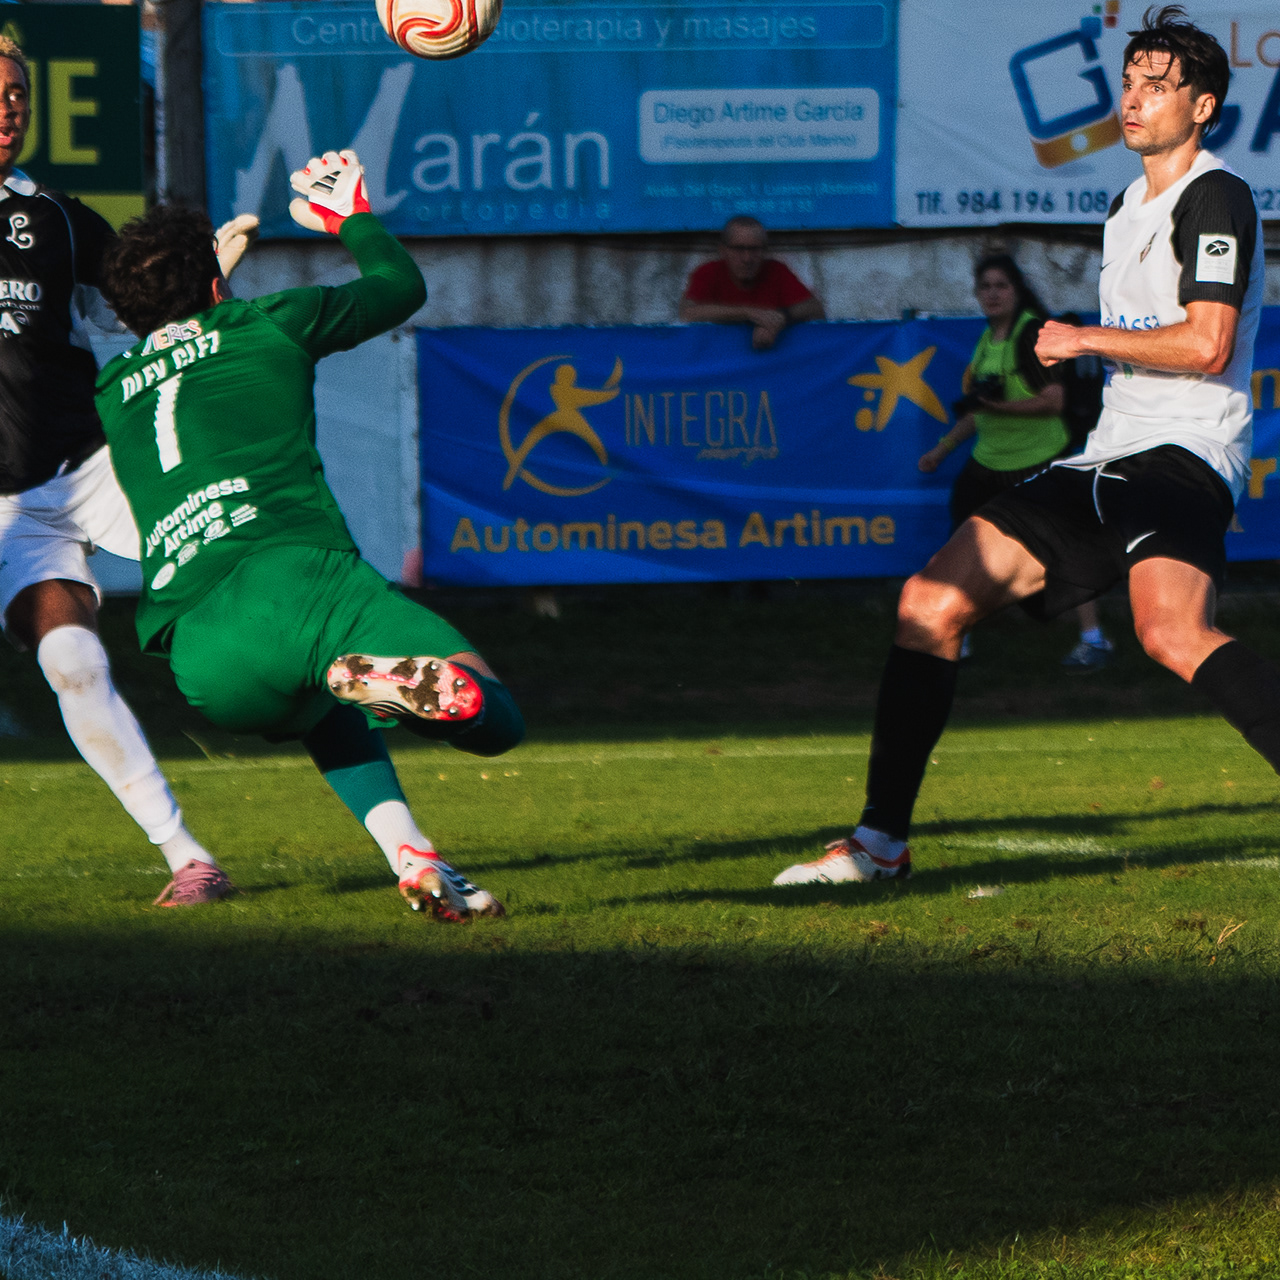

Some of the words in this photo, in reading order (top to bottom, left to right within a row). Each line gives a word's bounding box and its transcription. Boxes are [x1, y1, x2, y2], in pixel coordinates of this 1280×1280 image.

[291, 16, 386, 45] Centr
[655, 18, 670, 47] y
[684, 11, 818, 46] masajes
[654, 102, 714, 129] Diego
[722, 101, 788, 122] Artime
[232, 61, 610, 220] Marán
[416, 197, 611, 224] ortopedia
[915, 192, 950, 214] Tlf.
[956, 191, 1001, 213] 984
[1011, 191, 1056, 213] 196
[1066, 190, 1108, 213] 108
[625, 390, 777, 448] INTEGRA
[163, 501, 225, 558] Artime
[450, 514, 727, 554] Autominesa
[740, 510, 896, 548] Artime
